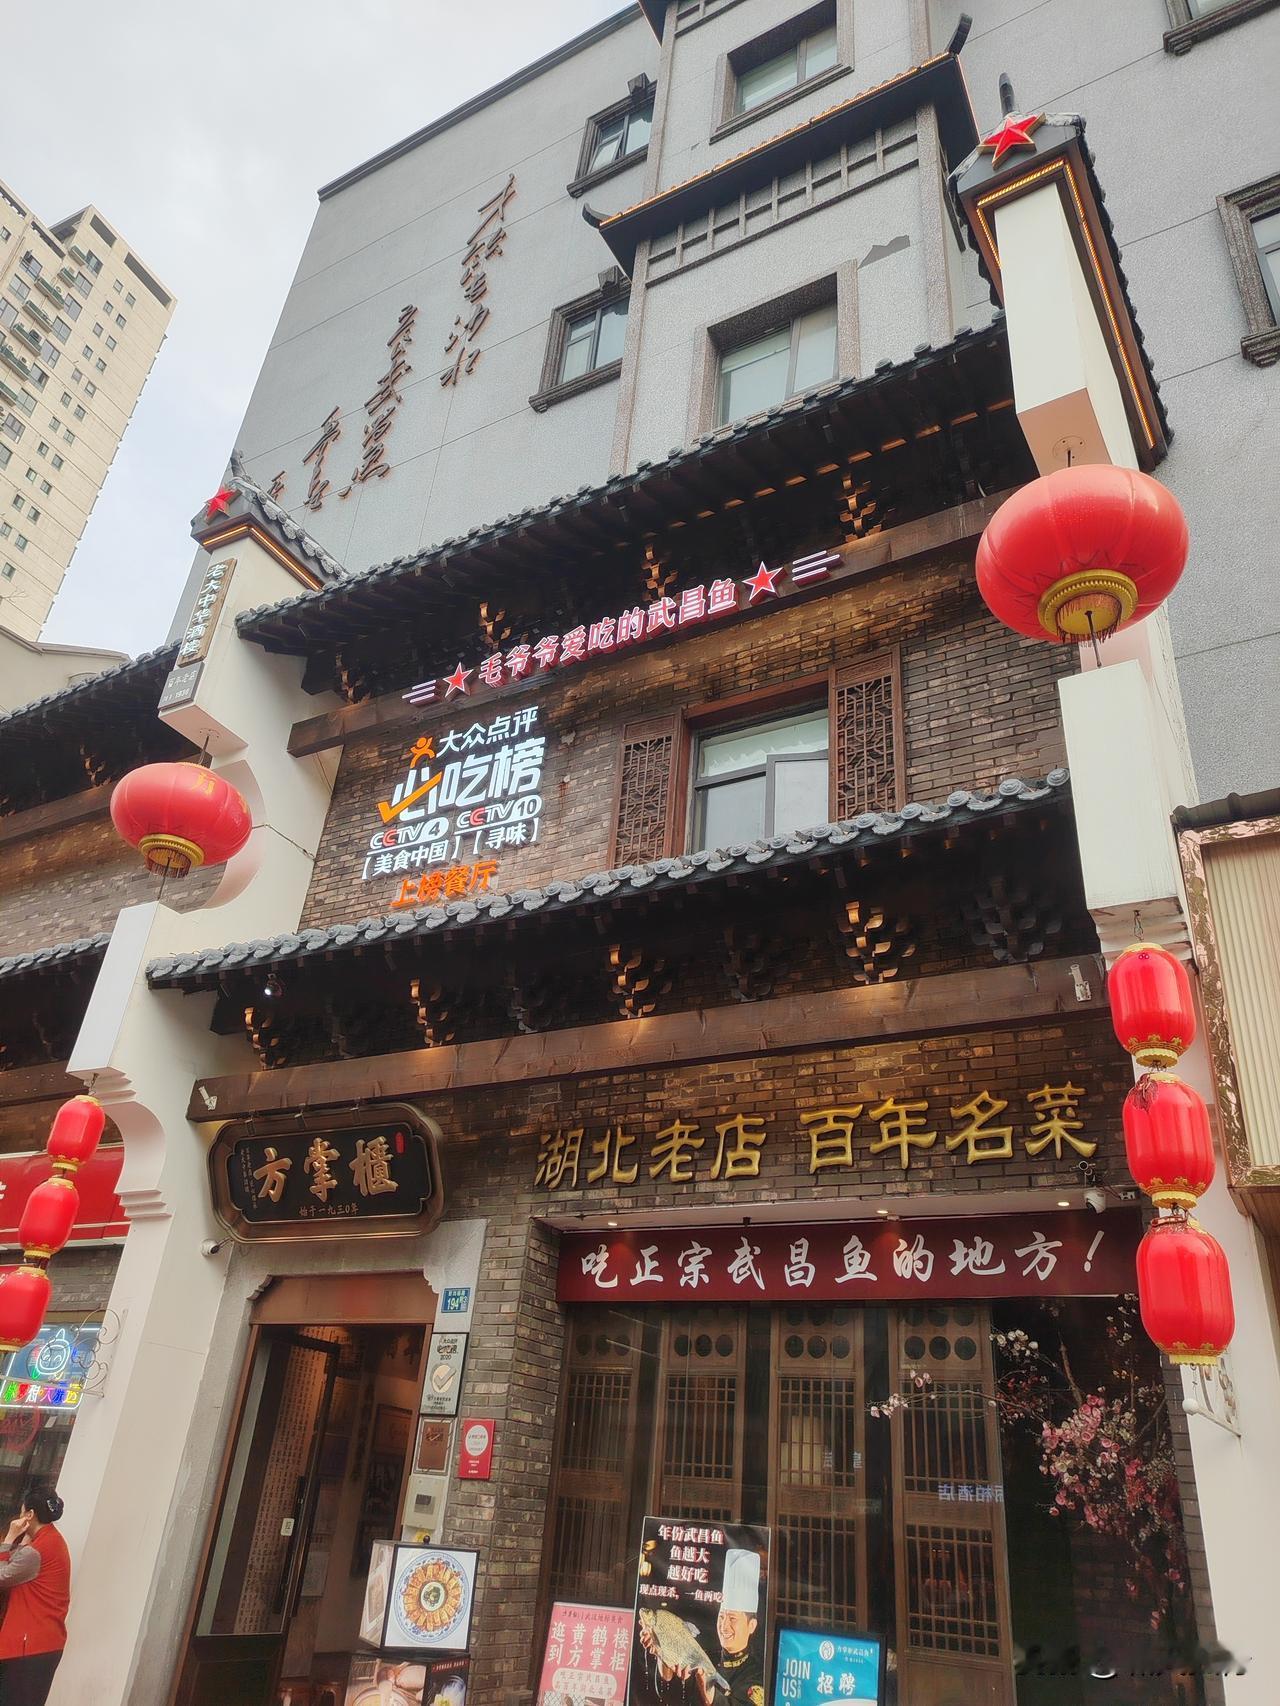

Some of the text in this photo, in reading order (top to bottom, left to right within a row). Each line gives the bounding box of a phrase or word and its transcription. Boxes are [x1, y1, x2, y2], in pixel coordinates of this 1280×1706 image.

[478, 580, 738, 687] 毛爷爷爱吃的武昌鱼
[436, 706, 538, 758] 大众点评
[377, 737, 545, 824] 必吃榜
[390, 859, 497, 908] 上榜餐厅
[534, 1080, 1097, 1190] 湖北老店 百年名菜
[658, 1524, 724, 1544] 年份武昌鱼
[669, 1545, 710, 1564] 鱼越大
[667, 1564, 708, 1583] 越好吃
[547, 1644, 627, 1672] 到方掌柜
[782, 1658, 811, 1680] JOIN
[781, 1678, 798, 1698] US
[816, 1671, 856, 1696] 招聘
